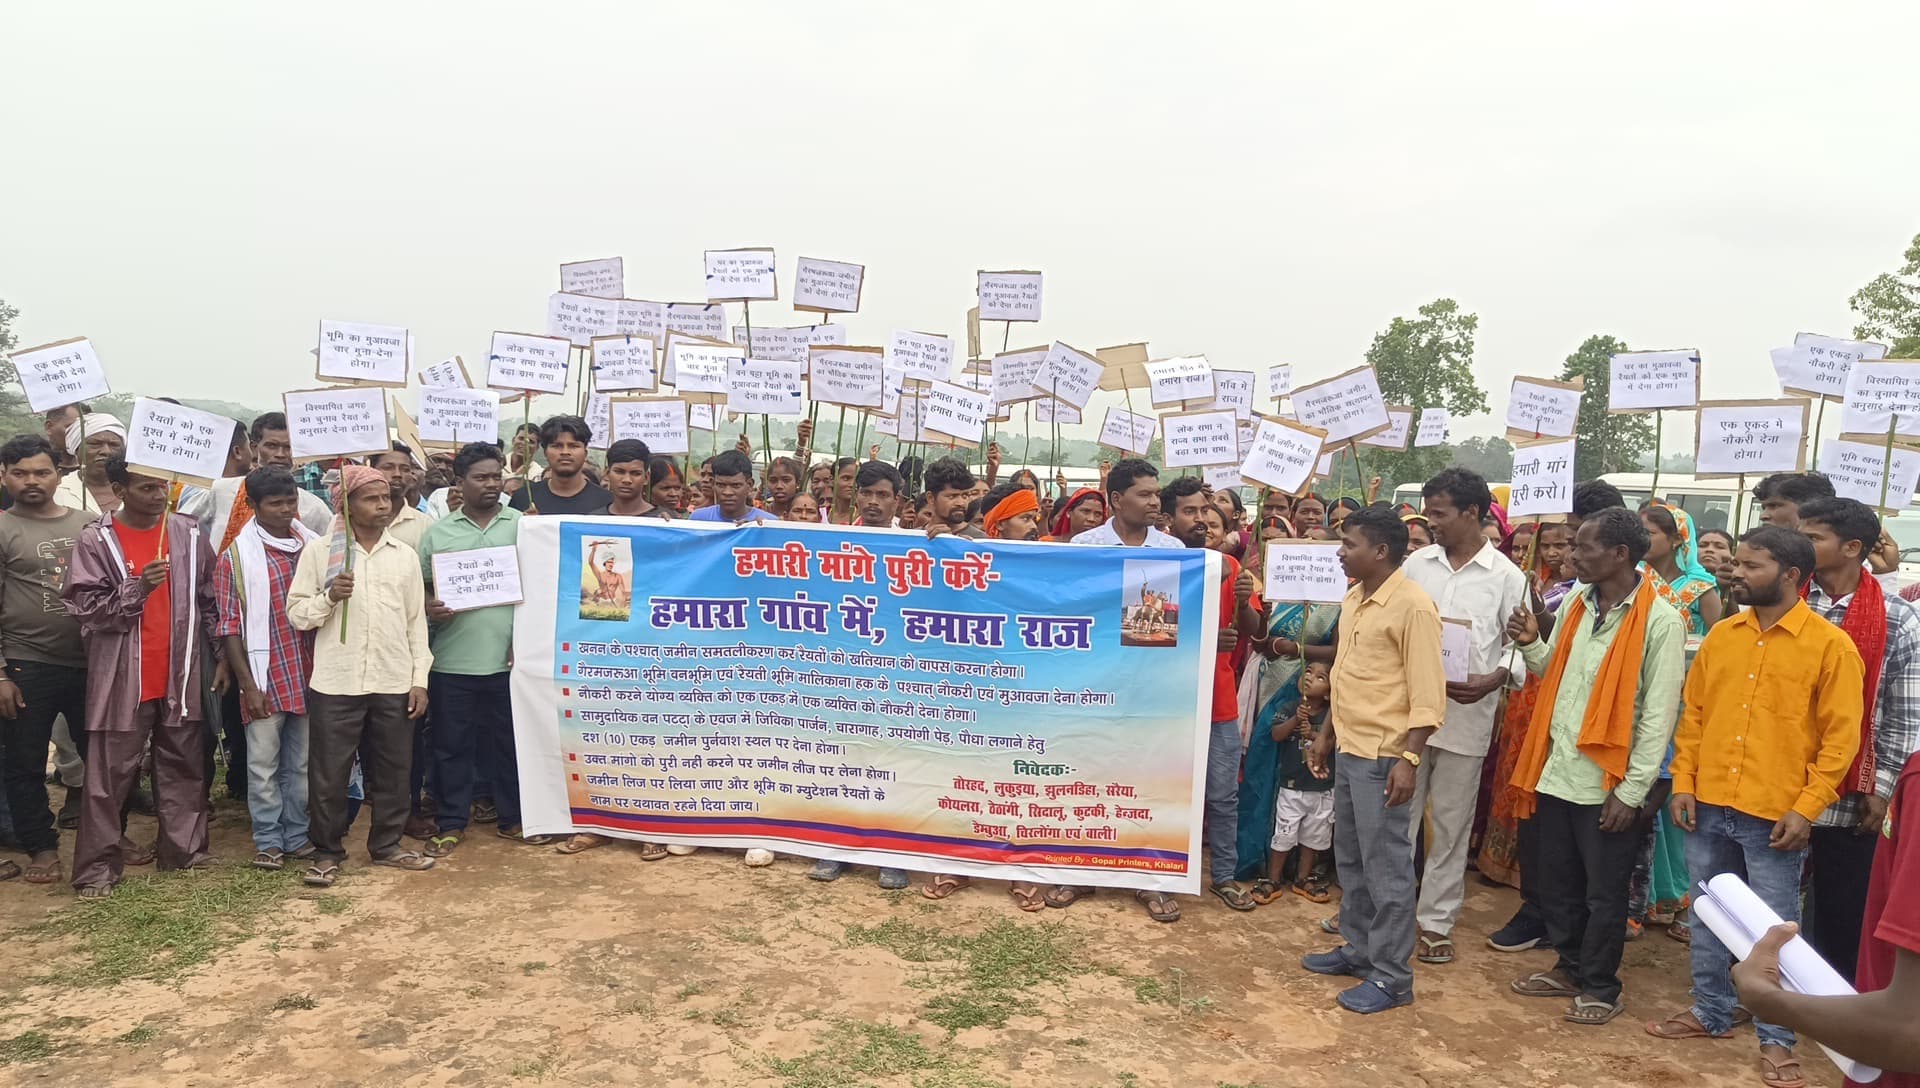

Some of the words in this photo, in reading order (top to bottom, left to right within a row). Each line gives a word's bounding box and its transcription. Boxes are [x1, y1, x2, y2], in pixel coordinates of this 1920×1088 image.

[733, 544, 810, 579] हमारी
[817, 546, 875, 583] मांगे
[884, 550, 933, 595] पुरी
[650, 598, 748, 629] हमारा
[760, 591, 830, 633] गांव
[901, 609, 1005, 648] हमारा
[1018, 616, 1092, 650] राज
[578, 642, 606, 656] खनन
[610, 640, 621, 654] के
[624, 644, 661, 661] पश्चात्
[663, 643, 697, 658] जमीन
[702, 643, 774, 658] समतलीकरण
[778, 650, 796, 661] कर
[830, 649, 846, 663] को
[849, 653, 895, 669] खतियान
[900, 655, 915, 670] को
[919, 661, 950, 674] वापस
[954, 663, 987, 677] करना
[578, 686, 612, 700] नौकरी
[616, 687, 641, 701] करने
[646, 691, 675, 702] योग्य
[679, 689, 713, 702] व्यक्ति
[717, 687, 733, 702] को
[736, 692, 756, 703] एक
[759, 693, 785, 706] एकड़
[789, 690, 799, 706] में
[802, 696, 821, 708] एक
[824, 696, 858, 712] व्यक्ति
[861, 697, 876, 712] को
[880, 700, 914, 717] नौकरी
[918, 703, 939, 718] देना
[580, 708, 638, 725] सामुदायिक
[641, 714, 658, 724] वन
[693, 711, 706, 725] के
[709, 714, 737, 725] एवज
[741, 711, 751, 725] में
[755, 711, 794, 727] जिविका
[797, 716, 832, 735] पार्जन,
[836, 722, 883, 739] चारागाह,
[887, 725, 930, 741] उपयोगी
[934, 726, 954, 746] पेड़,
[959, 729, 984, 746] पौधा
[988, 734, 1023, 749] लगाने
[1027, 735, 1045, 755] हेतु
[582, 732, 600, 743] दश
[605, 732, 626, 746] (10)
[630, 734, 656, 748] एकड़
[663, 732, 697, 746] जमीन
[745, 737, 771, 747] स्थल
[775, 738, 789, 750] पर
[793, 736, 812, 753] देना
[584, 753, 607, 765] उक्त
[640, 753, 655, 767] को
[659, 754, 678, 773] पुरी
[707, 754, 734, 768] करने
[738, 759, 753, 769] पर
[757, 756, 789, 771] जमीन
[792, 759, 816, 774] लीज
[819, 765, 835, 777] पर
[838, 763, 861, 777] लेना
[953, 777, 988, 794] तोरहद,
[1105, 784, 1137, 800] सरैया,
[938, 797, 983, 817] कोयलरा,
[1029, 805, 1067, 822] सिदालू,
[1073, 804, 1109, 820] कुटकी,
[1064, 828, 1081, 840] एवं
[1045, 855, 1072, 863] Printed
[1074, 856, 1085, 865] By
[1091, 856, 1116, 865] Gopal
[1118, 859, 1152, 869] Printers,
[1154, 861, 1184, 870] Khalari
